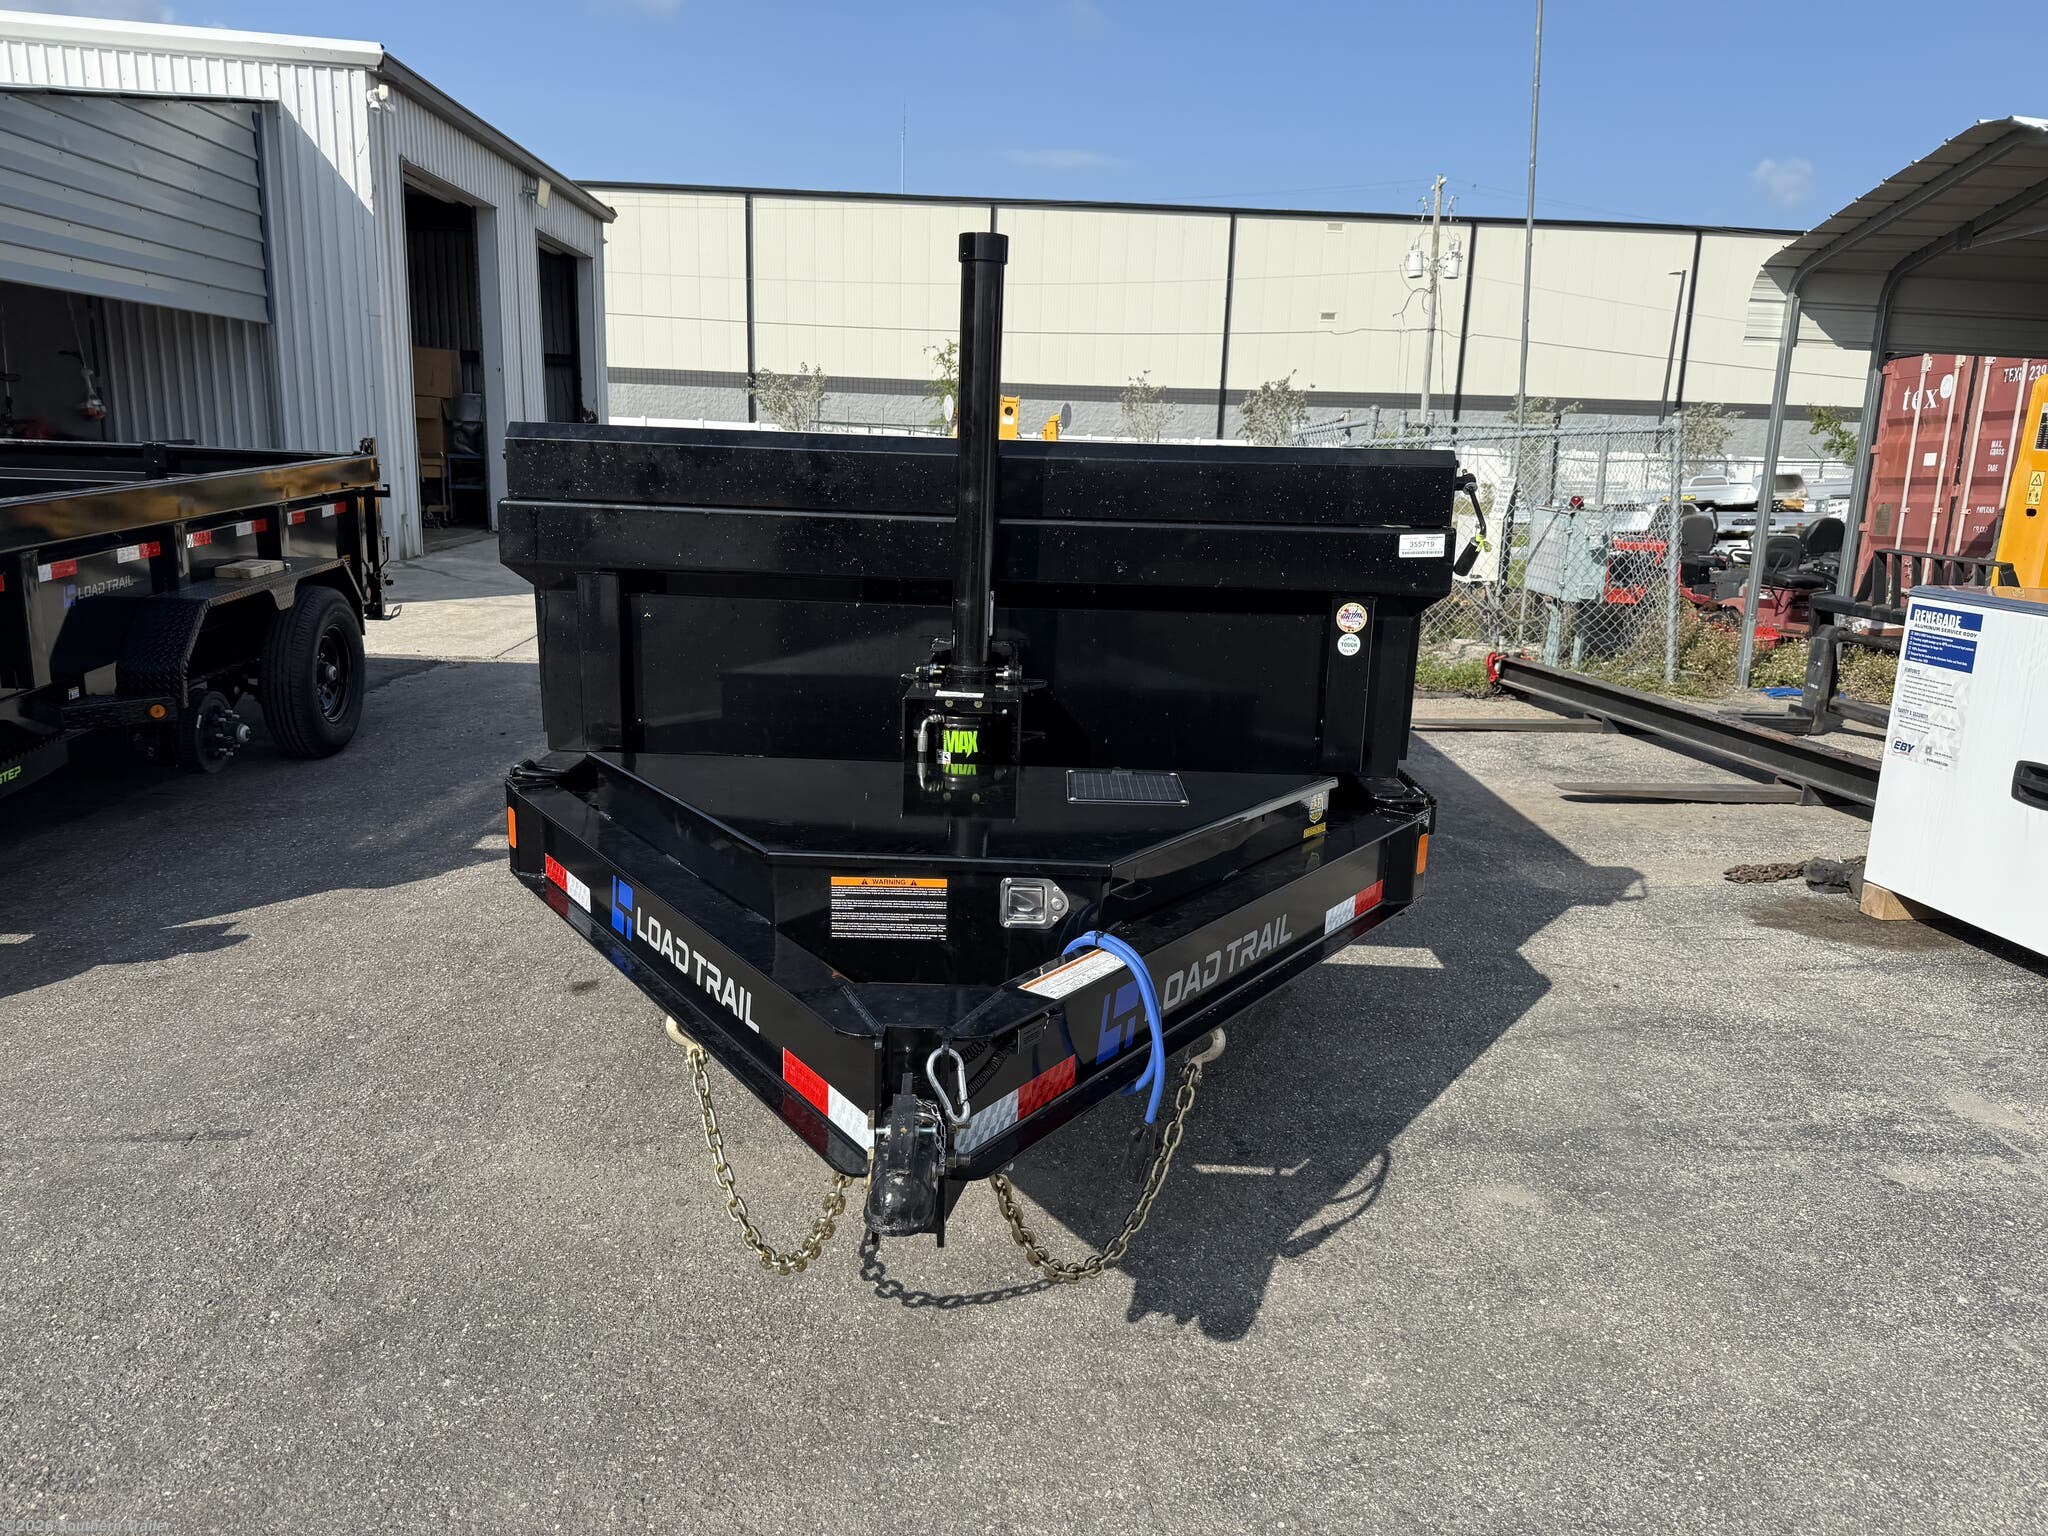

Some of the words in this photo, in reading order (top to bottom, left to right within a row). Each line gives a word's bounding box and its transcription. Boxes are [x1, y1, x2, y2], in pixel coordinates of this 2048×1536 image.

[78, 582, 105, 600] LOAD
[106, 575, 134, 592] TRAIL
[1914, 608, 1962, 629] RENEGADE
[1914, 623, 1940, 632] ALUMINUM
[1941, 627, 1962, 636] SERVICE
[943, 730, 978, 758] MAX
[1894, 740, 1915, 753] EBY
[636, 906, 690, 975] LOAD
[692, 950, 760, 1034] TRAIL
[1146, 950, 1222, 1021] OAD
[1227, 913, 1293, 974] TRAIL
